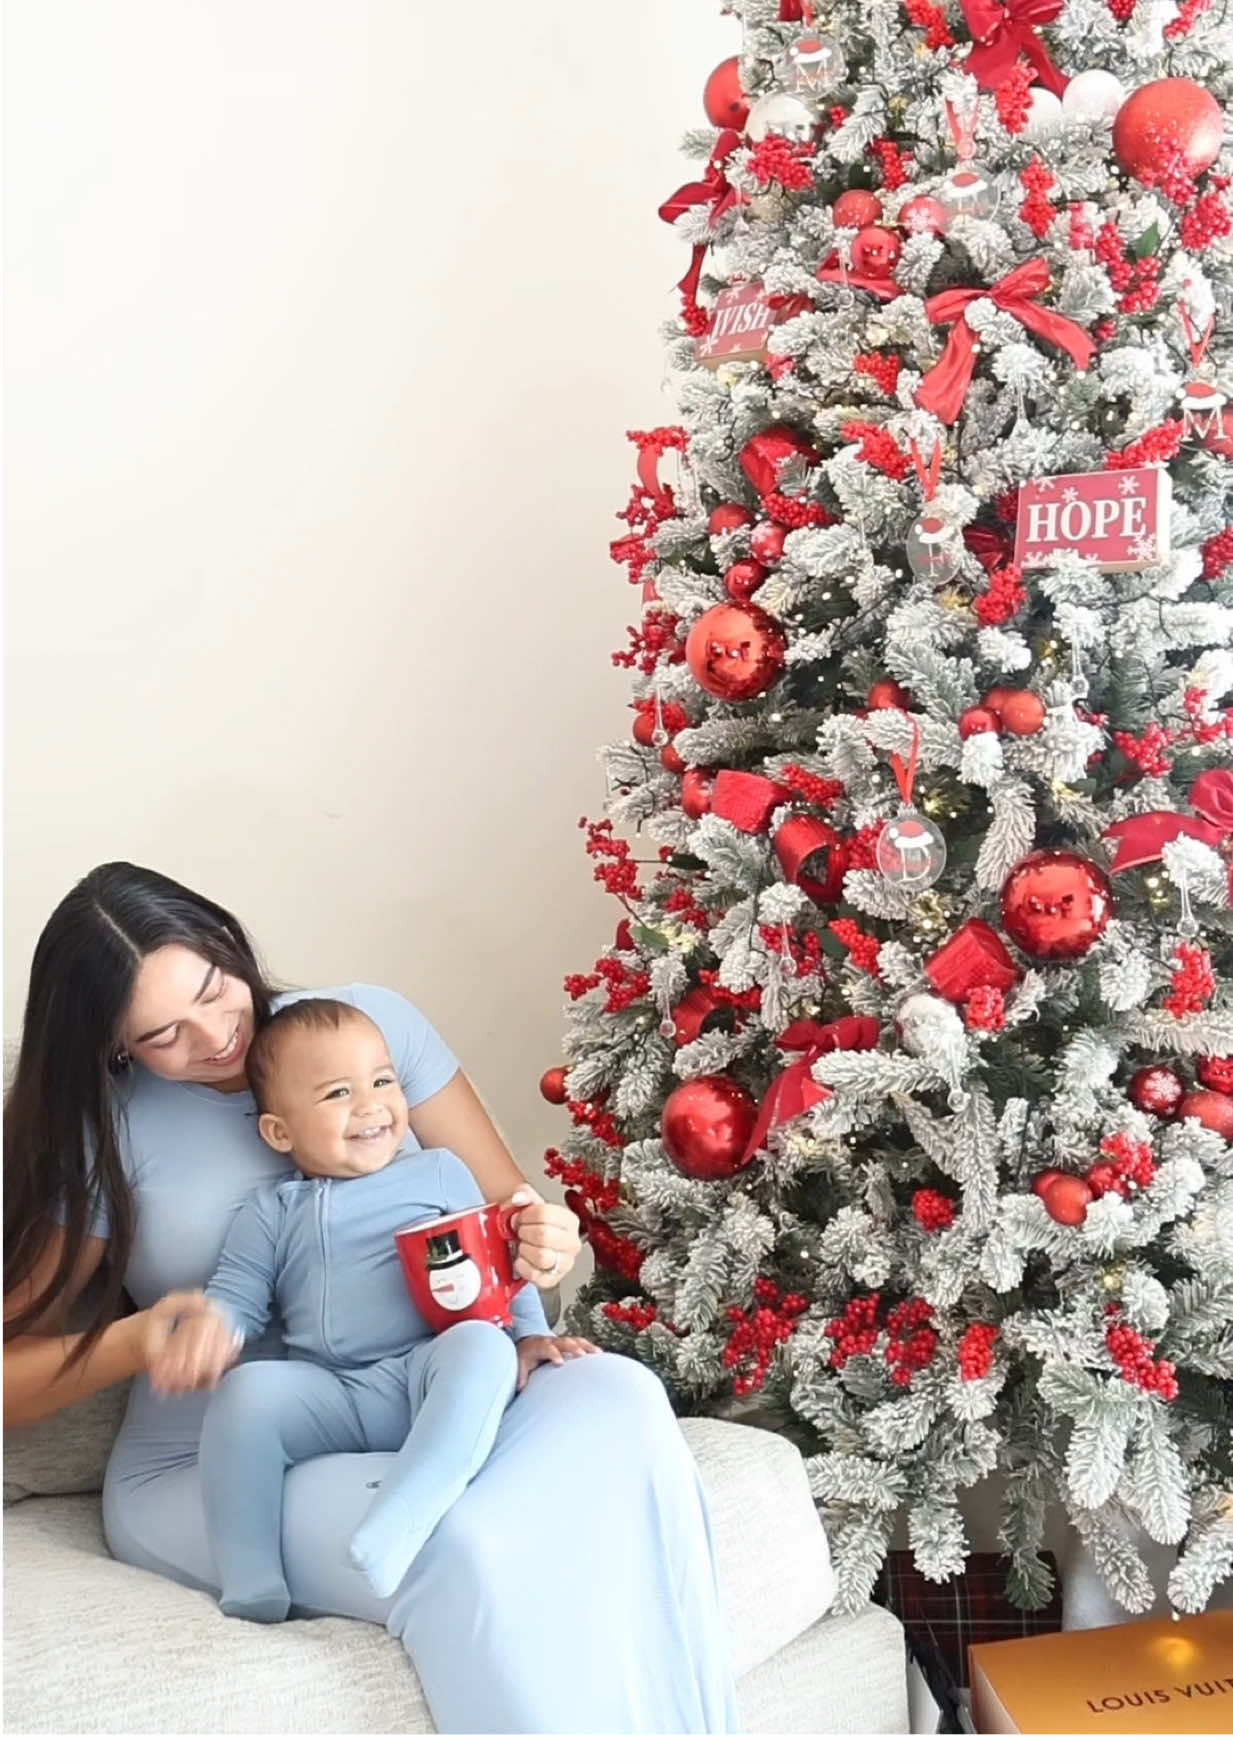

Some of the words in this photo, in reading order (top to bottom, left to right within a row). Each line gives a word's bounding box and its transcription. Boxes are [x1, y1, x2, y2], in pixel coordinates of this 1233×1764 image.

[711, 301, 770, 339] WISH
[1180, 405, 1230, 442] M
[1025, 496, 1147, 543] HOPE
[1086, 1689, 1171, 1713] LOUIS
